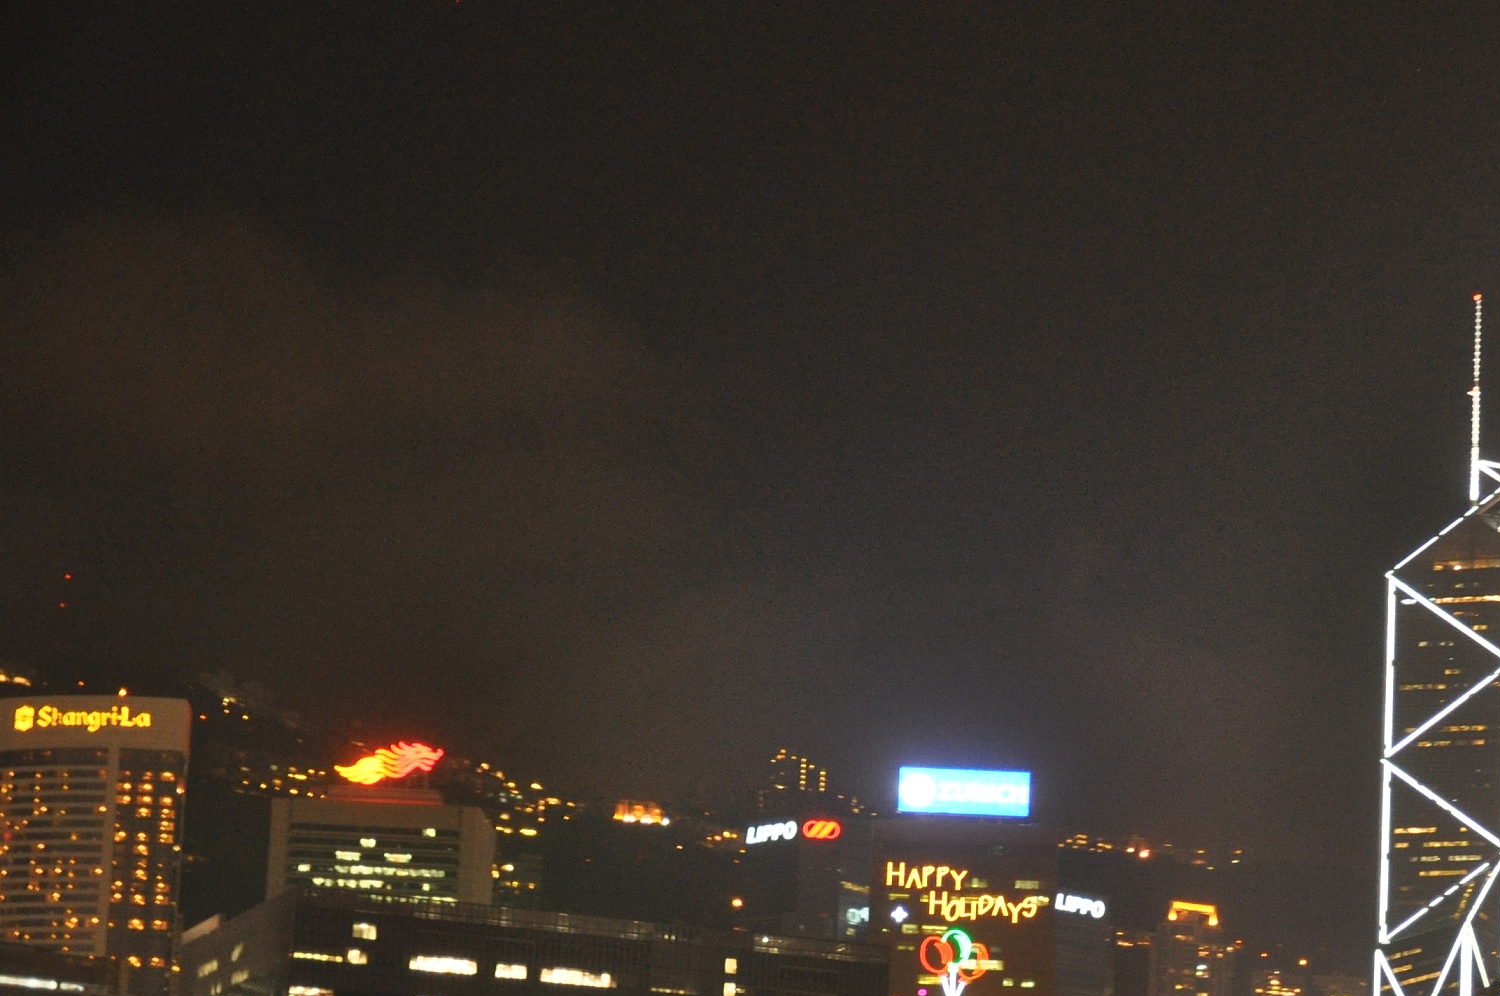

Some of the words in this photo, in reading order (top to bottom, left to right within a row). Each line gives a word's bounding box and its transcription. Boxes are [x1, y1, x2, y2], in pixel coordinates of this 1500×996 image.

[36, 705, 151, 732] Shangri-La
[745, 820, 798, 845] LIPPO
[885, 861, 968, 891] HAPPY
[928, 890, 1039, 924] HOLIDAYS
[1054, 893, 1106, 919] LIPPO
